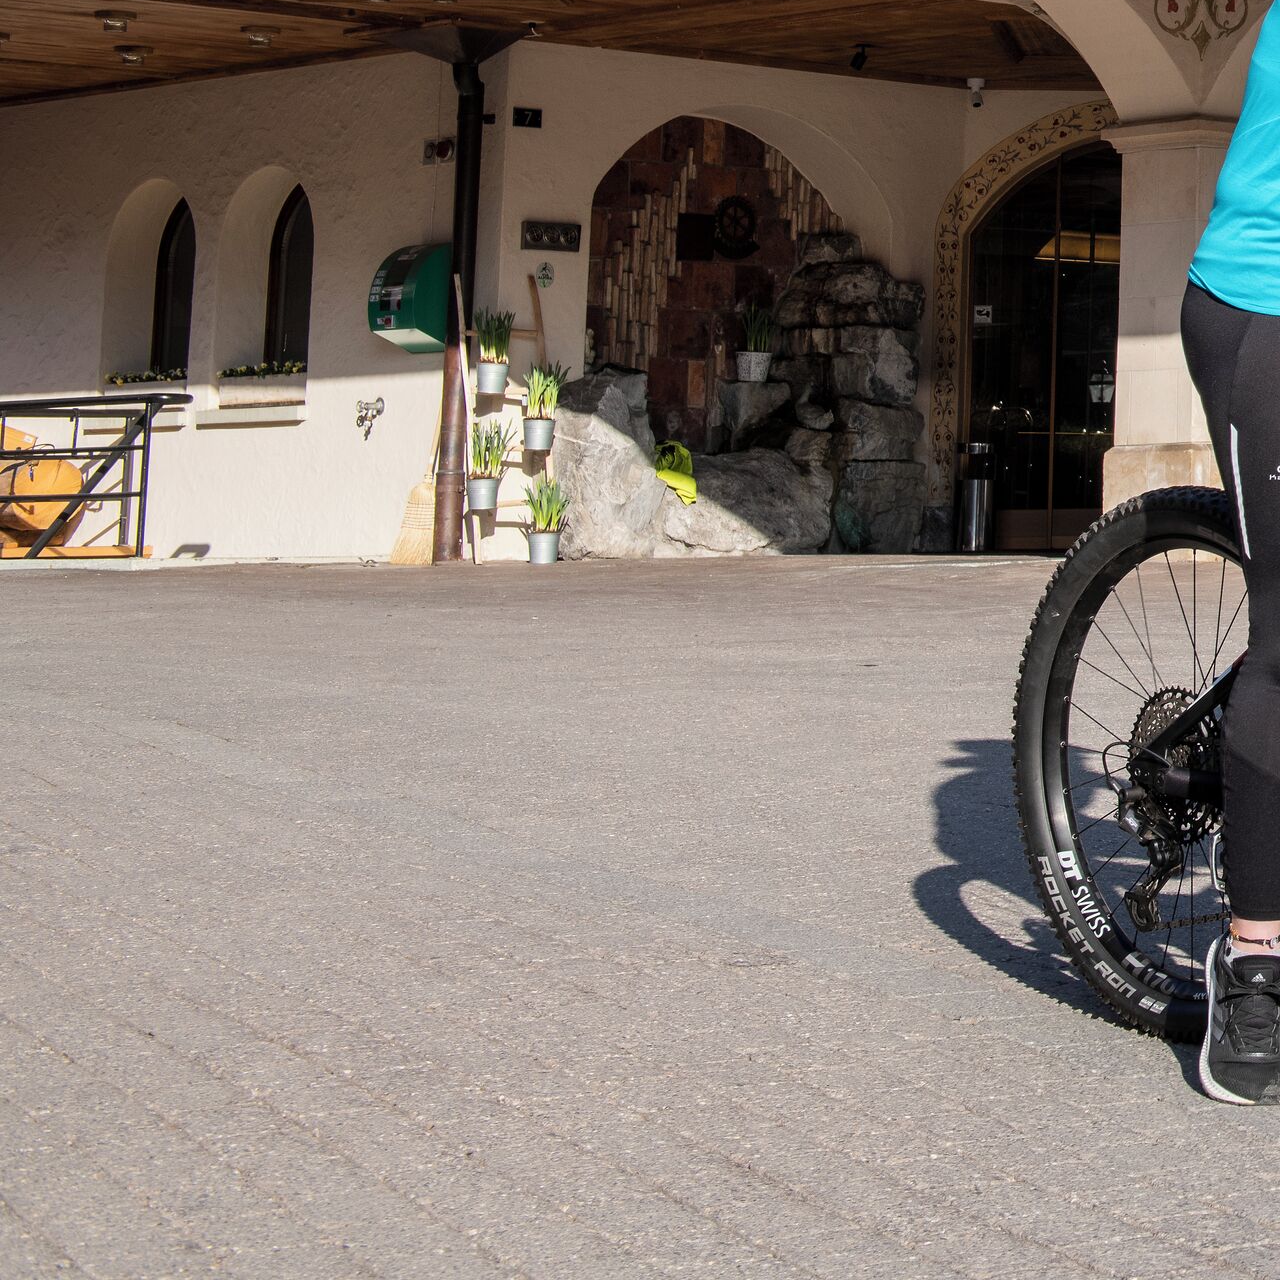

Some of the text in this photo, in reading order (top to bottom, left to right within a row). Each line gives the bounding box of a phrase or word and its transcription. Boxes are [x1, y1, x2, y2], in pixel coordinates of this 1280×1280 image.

[524, 111, 533, 125] 7
[1037, 856, 1094, 954] ROCKET
[1094, 960, 1137, 999] RON
[1057, 850, 1111, 939] DT SWISS
